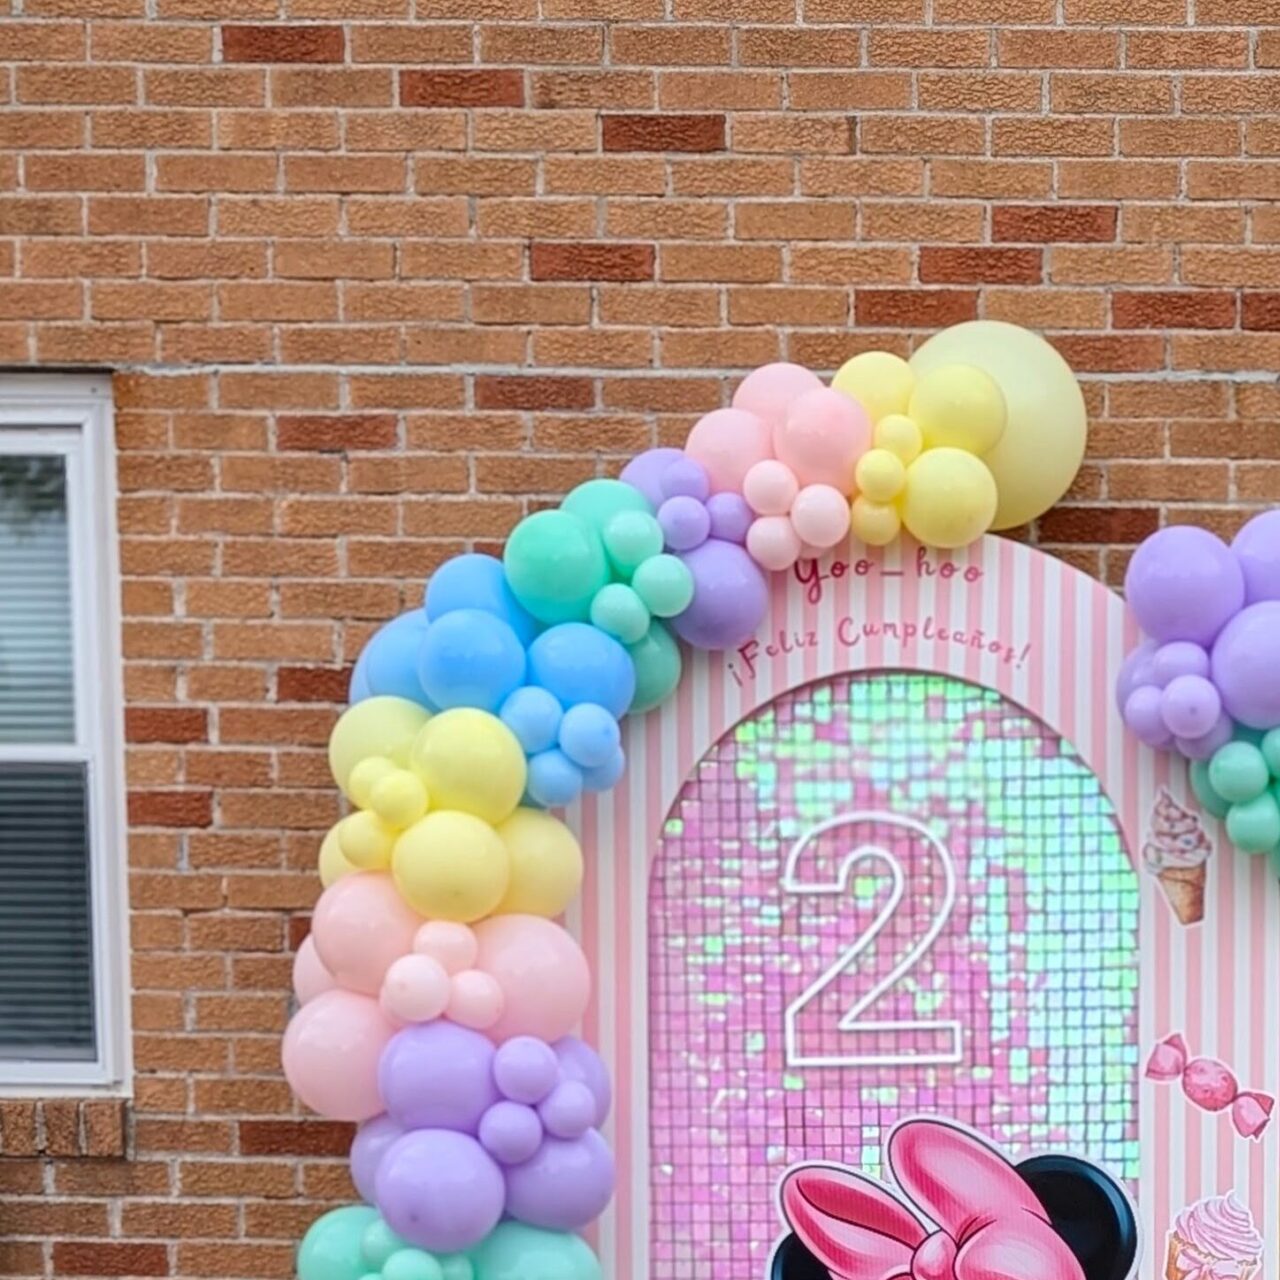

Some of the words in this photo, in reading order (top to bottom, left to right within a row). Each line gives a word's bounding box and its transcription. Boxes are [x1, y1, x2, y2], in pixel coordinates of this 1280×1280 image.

[728, 630, 819, 688] ¡Feliz
[837, 616, 1032, 670] Cumpleaños!
[784, 809, 962, 1067] 2
